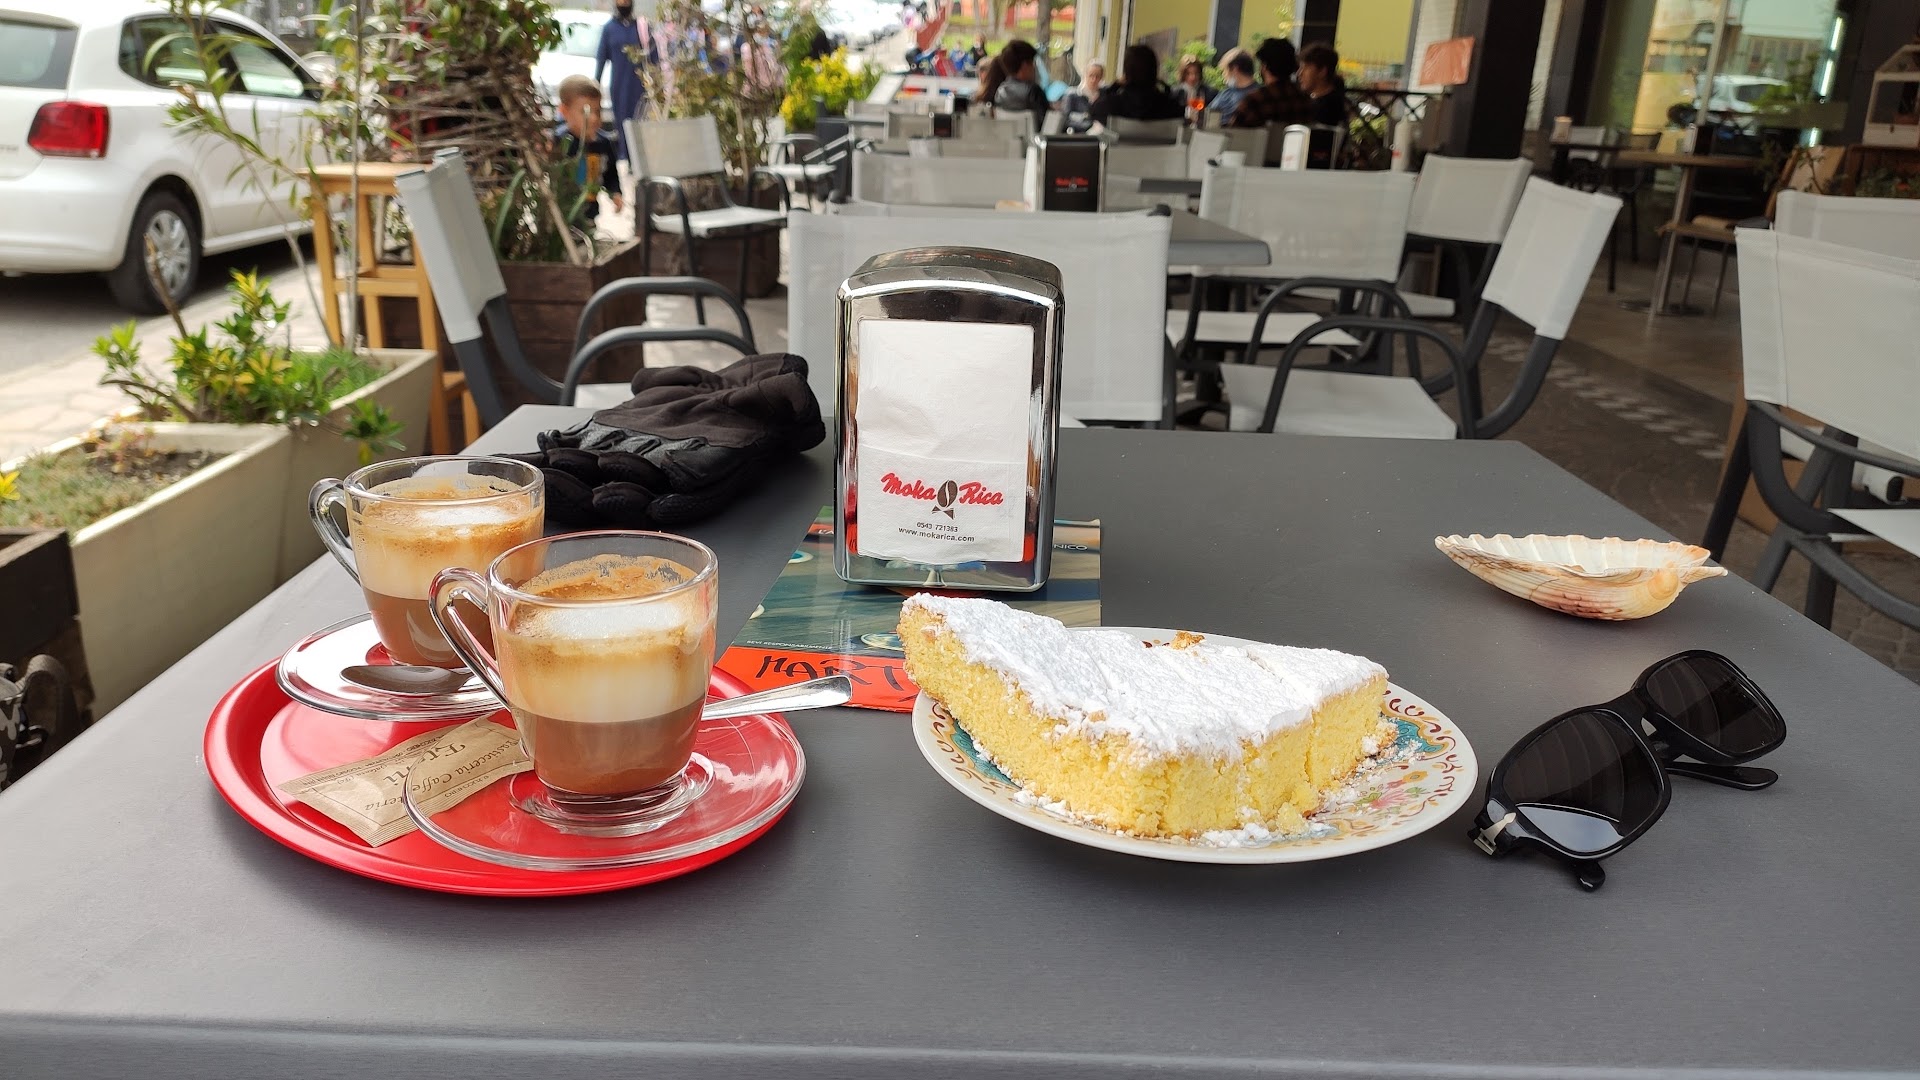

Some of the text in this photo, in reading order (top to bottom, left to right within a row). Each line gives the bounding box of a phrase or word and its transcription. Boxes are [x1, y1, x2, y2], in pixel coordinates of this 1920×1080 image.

[881, 472, 1004, 505] Moka Rica
[898, 527, 975, 542] www.mokarica.com
[916, 521, 933, 530] 0543
[1053, 543, 1088, 551] NICO
[755, 655, 907, 692] MART
[365, 740, 519, 812] Pasticceria Caffeteria
